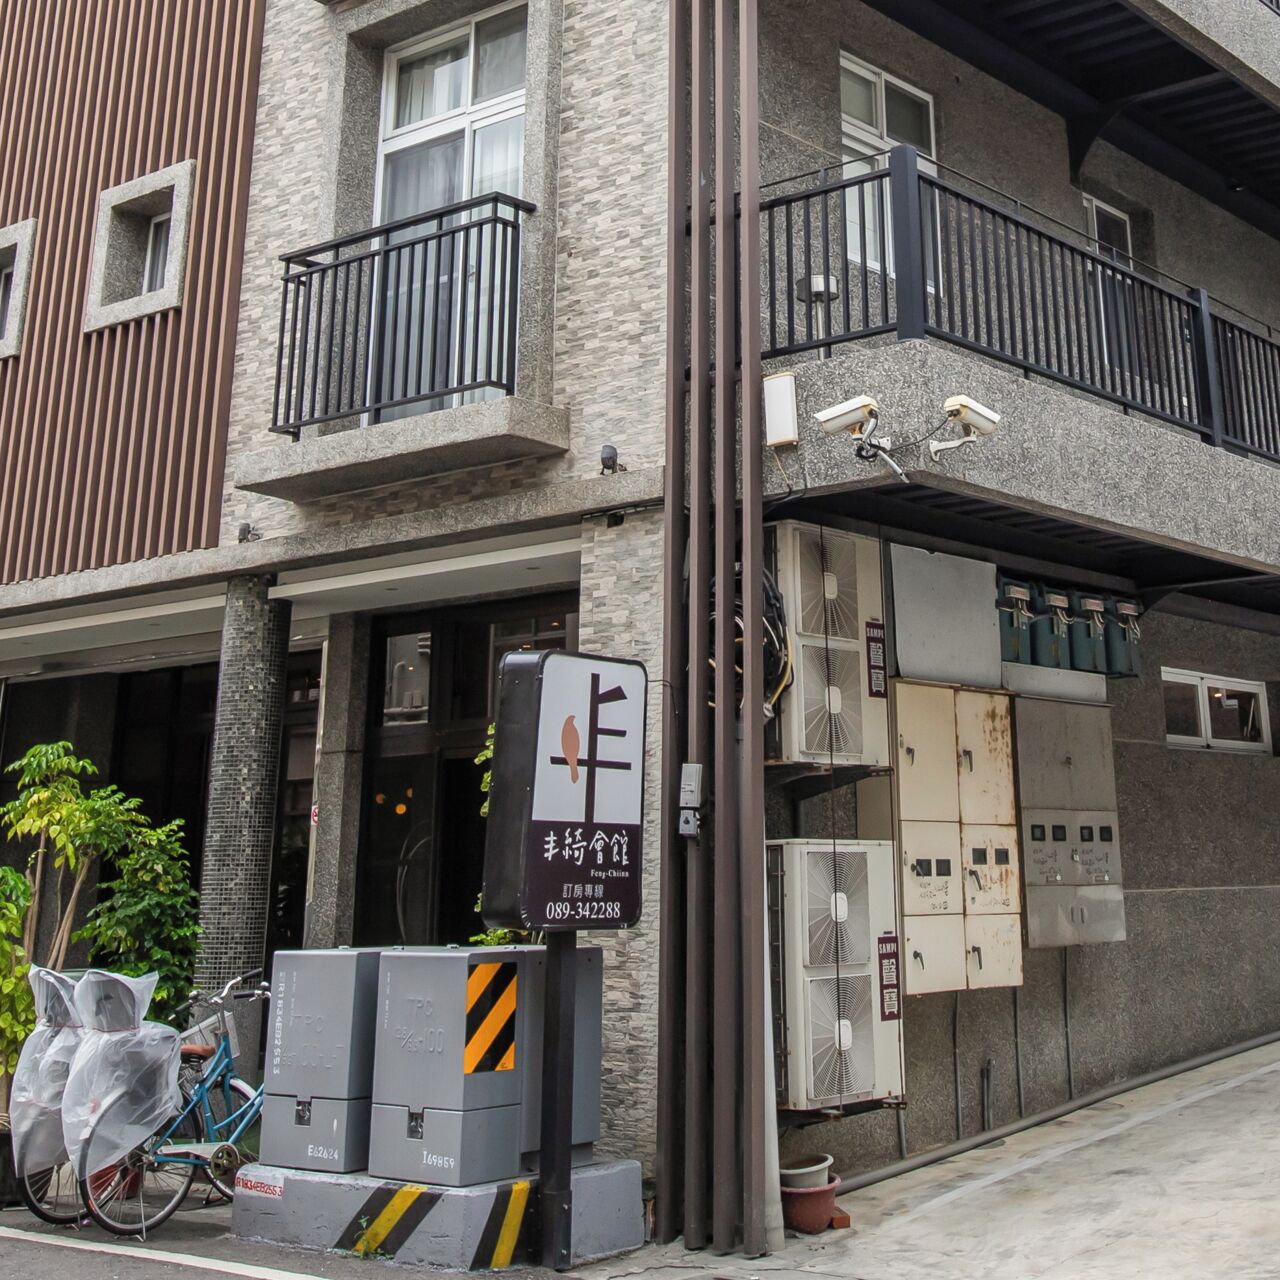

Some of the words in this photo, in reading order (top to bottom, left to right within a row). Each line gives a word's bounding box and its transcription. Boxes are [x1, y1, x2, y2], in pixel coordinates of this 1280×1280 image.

[562, 883, 605, 899] 訂房專線
[546, 901, 621, 921] 089-342288
[881, 958, 898, 1016] 聲寶
